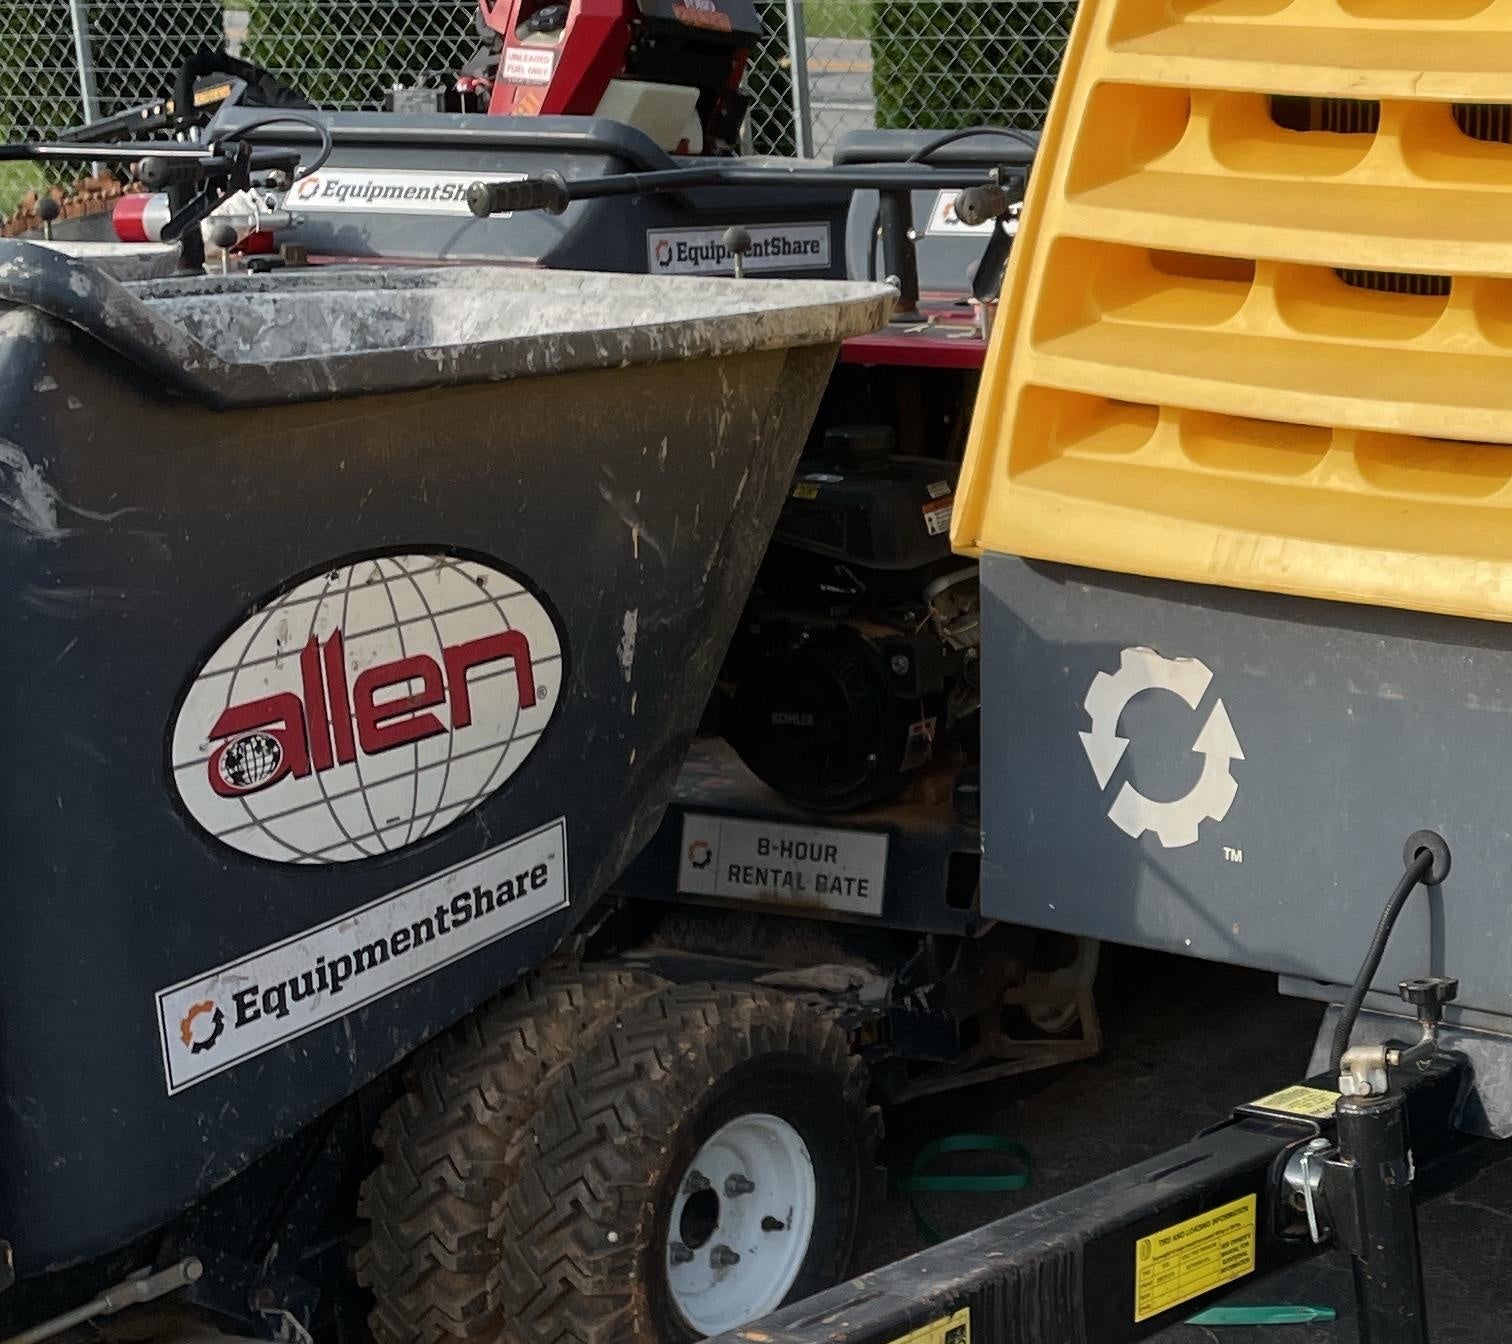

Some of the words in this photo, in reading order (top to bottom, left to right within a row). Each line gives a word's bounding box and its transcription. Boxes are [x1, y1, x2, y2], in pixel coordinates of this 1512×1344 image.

[207, 626, 537, 798] allen
[728, 864, 806, 891] RENTAL
[1222, 846, 1243, 863] TM
[232, 862, 549, 1029] EquipmentShare
